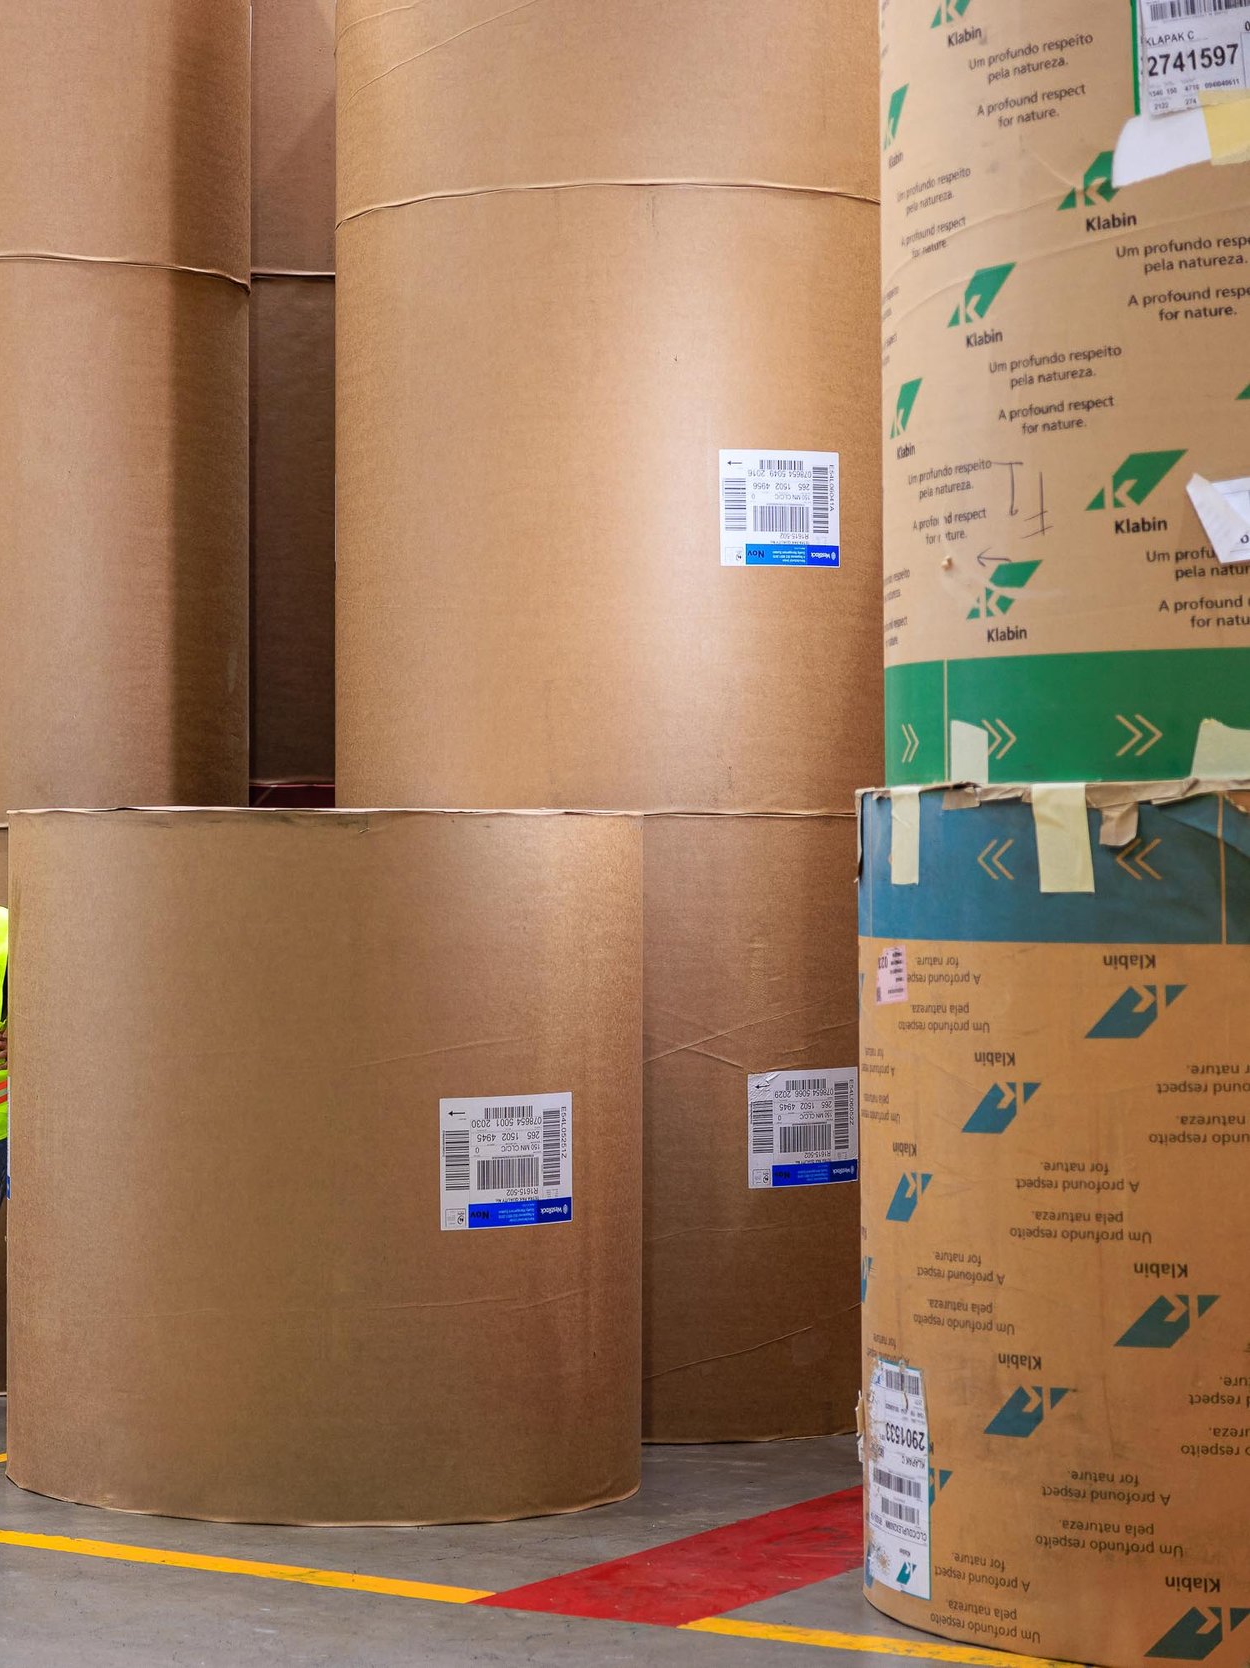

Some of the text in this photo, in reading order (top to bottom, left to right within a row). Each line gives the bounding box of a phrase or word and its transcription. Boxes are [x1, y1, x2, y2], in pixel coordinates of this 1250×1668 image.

[948, 26, 982, 48] Klabin
[1188, 31, 1194, 40] C
[969, 32, 1094, 70] Um profundo respeito
[1147, 43, 1239, 76] 2741597
[988, 55, 1069, 84] pela natureza.
[977, 84, 1086, 118] A profound respect
[998, 107, 1060, 128] for nature.
[1085, 212, 1138, 232] Klabin
[1116, 237, 1212, 258] Um profundo
[1144, 254, 1248, 276] pela natureza.
[1128, 288, 1211, 307] A profound
[1158, 304, 1238, 321] for nature.
[966, 329, 1003, 348] Klabin
[989, 344, 1122, 374] Um profundo respeito
[1009, 366, 1096, 390] pela natureza.
[998, 395, 1115, 422] A profound respect
[1021, 417, 1087, 436] for nature.
[896, 443, 916, 460] Klabin
[918, 479, 974, 501] pela natureza.
[953, 509, 987, 525] respect
[1114, 516, 1168, 535] Klabin
[1145, 550, 1171, 563] Um
[1175, 565, 1206, 581] pela
[1159, 597, 1244, 613] A profound
[1190, 614, 1215, 629] for
[987, 625, 1028, 642] Klabin
[916, 956, 959, 968] for nature.
[1103, 955, 1156, 969] Klabin
[928, 973, 981, 986] A profound
[910, 1003, 969, 1015] pela natureza.
[898, 1020, 990, 1034] Um profundo respeito
[974, 1052, 1016, 1066] Klabin
[1188, 1065, 1240, 1075] nature.
[813, 1088, 833, 1096] 078654
[1156, 1083, 1208, 1095] respect
[472, 1119, 491, 1128] 2030
[517, 1117, 542, 1125] 078654
[1176, 1115, 1246, 1125] natureza.
[477, 1134, 496, 1142] 4945
[502, 1133, 519, 1141] 1502
[1149, 1133, 1207, 1145] respeito
[892, 1142, 918, 1157] Klabin
[1041, 1162, 1108, 1175] for nature.
[1016, 1178, 1140, 1192] A profound respect
[471, 1206, 562, 1219] WestRock Nov
[1032, 1210, 1124, 1223] pela natureza.
[1010, 1227, 1152, 1244] Um profundo respeito
[933, 1251, 981, 1266] for nature.
[917, 1267, 1005, 1286] A profound respect
[1133, 1263, 1188, 1277] Klabin
[928, 1299, 993, 1314] pela natureza.
[914, 1314, 1015, 1335] Um profundo respeito
[998, 1353, 1042, 1370] Klabin
[1188, 1395, 1241, 1405] respect
[886, 1423, 925, 1451] 2901533
[1181, 1445, 1240, 1457] respeito
[1067, 1469, 1139, 1486] for nature.
[1042, 1486, 1171, 1506] A profound respect
[1058, 1519, 1154, 1537] pela natureza.
[1035, 1535, 1184, 1559] Um profundo respeito
[951, 1551, 1005, 1574] for nature.
[934, 1566, 1031, 1592] A profound respect
[1165, 1576, 1221, 1592] Klabin
[946, 1600, 1017, 1621] pela natureza.
[930, 1612, 1041, 1644] Um profundo respeito
